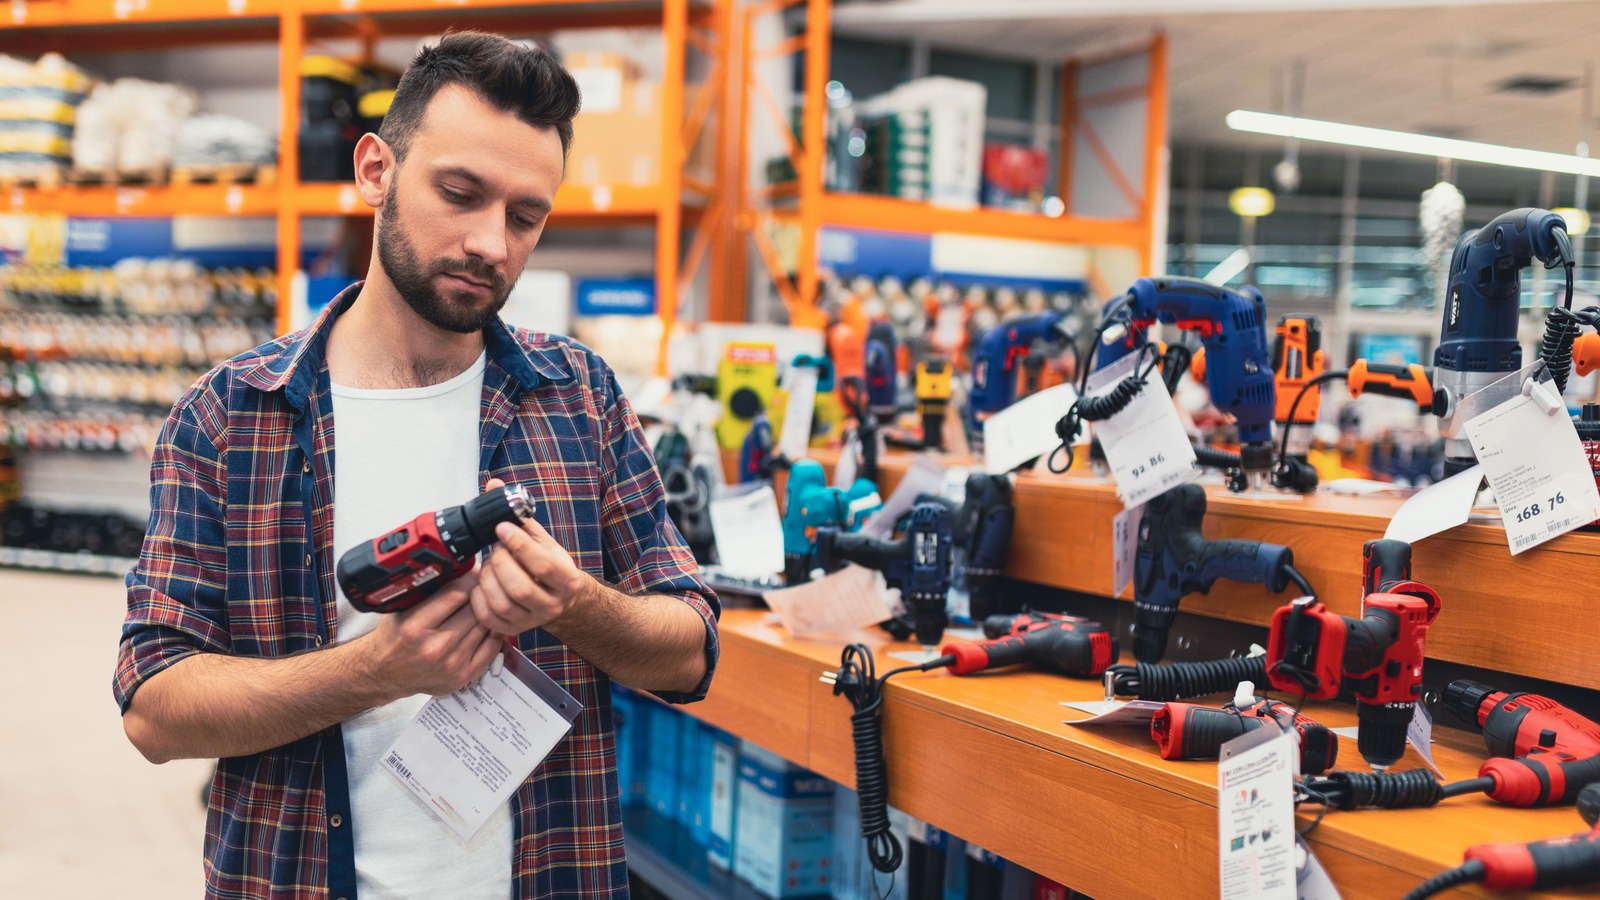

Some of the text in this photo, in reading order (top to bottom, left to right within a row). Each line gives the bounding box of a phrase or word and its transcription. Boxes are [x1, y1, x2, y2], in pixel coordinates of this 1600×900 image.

[1503, 504, 1518, 513] Цена:
[1516, 492, 1564, 522] 168 76
